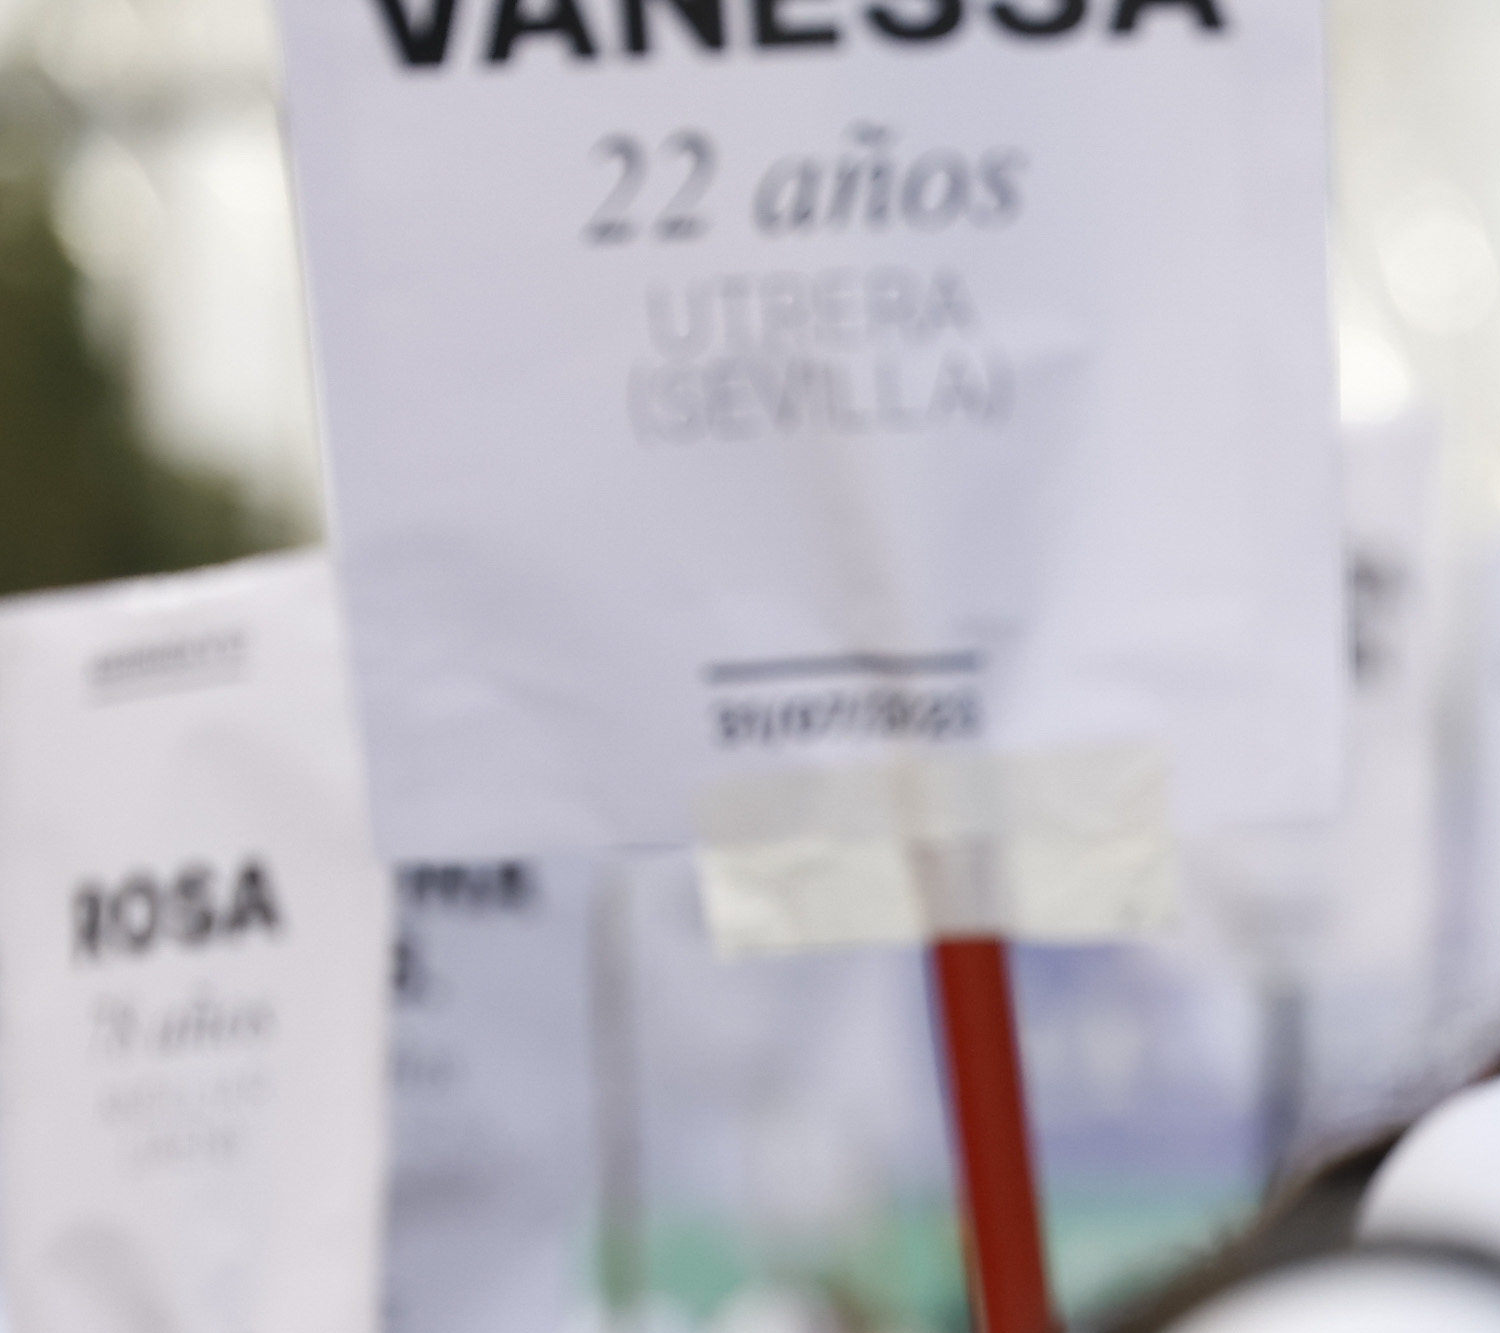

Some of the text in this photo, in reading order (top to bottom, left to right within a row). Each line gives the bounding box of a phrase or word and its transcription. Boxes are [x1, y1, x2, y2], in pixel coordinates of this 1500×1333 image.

[582, 118, 1028, 248] 22 años
[643, 264, 980, 362] UTRERA
[626, 346, 1017, 450] (SEVILLA)
